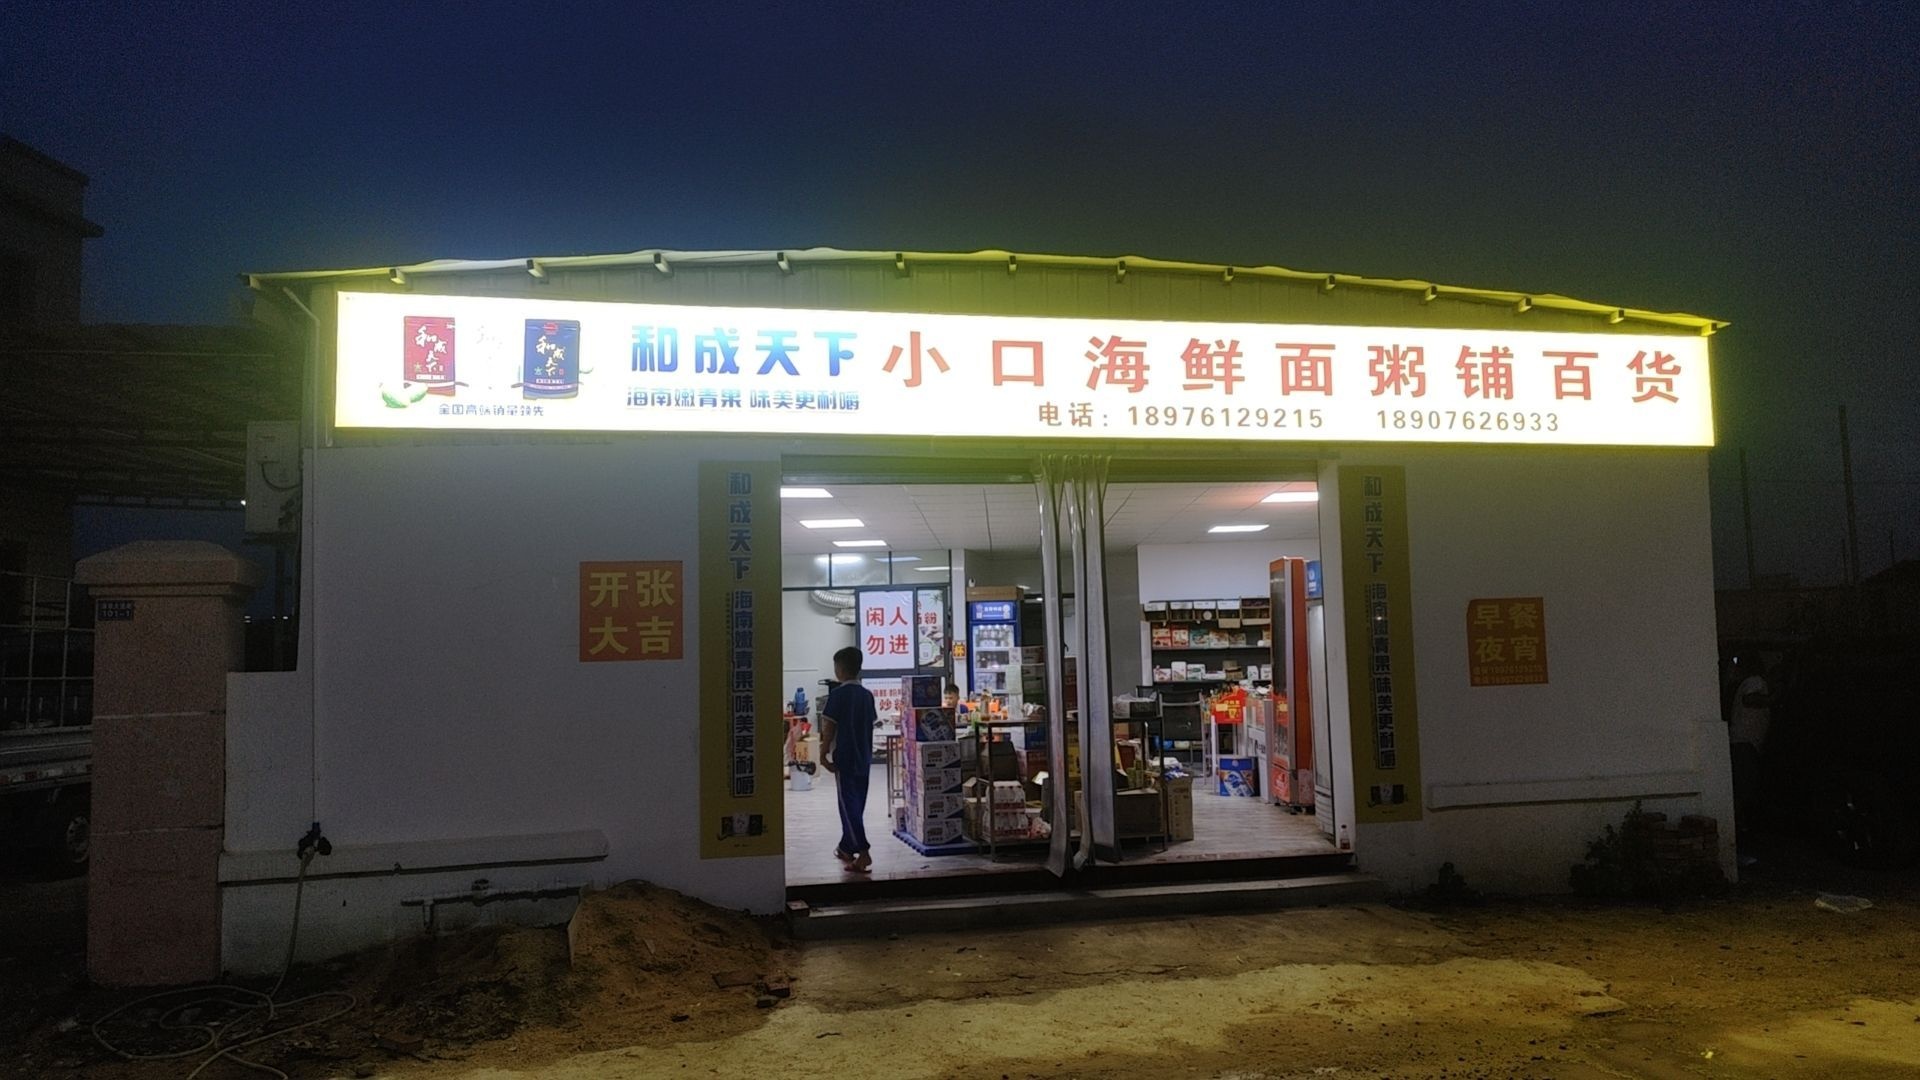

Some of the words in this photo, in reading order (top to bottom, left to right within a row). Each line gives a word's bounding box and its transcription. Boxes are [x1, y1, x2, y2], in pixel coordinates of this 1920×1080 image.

[631, 325, 858, 377] 和成天下
[882, 330, 1682, 404] 小口海鲜面粥铺百货
[627, 386, 742, 409] 海南嫩青果
[749, 388, 861, 412] 味美更耐嚼
[1377, 410, 1560, 432] 18907626933
[729, 471, 752, 580] 和成天下
[1363, 475, 1384, 574] 和成天下
[588, 568, 675, 608] 开张
[588, 615, 675, 655] 大吉
[866, 606, 908, 627] 闲人
[1473, 602, 1538, 630] 早餐
[734, 590, 755, 688] 海南嫩青果
[866, 634, 910, 656] 勿进
[1474, 635, 1540, 664] 夜宵
